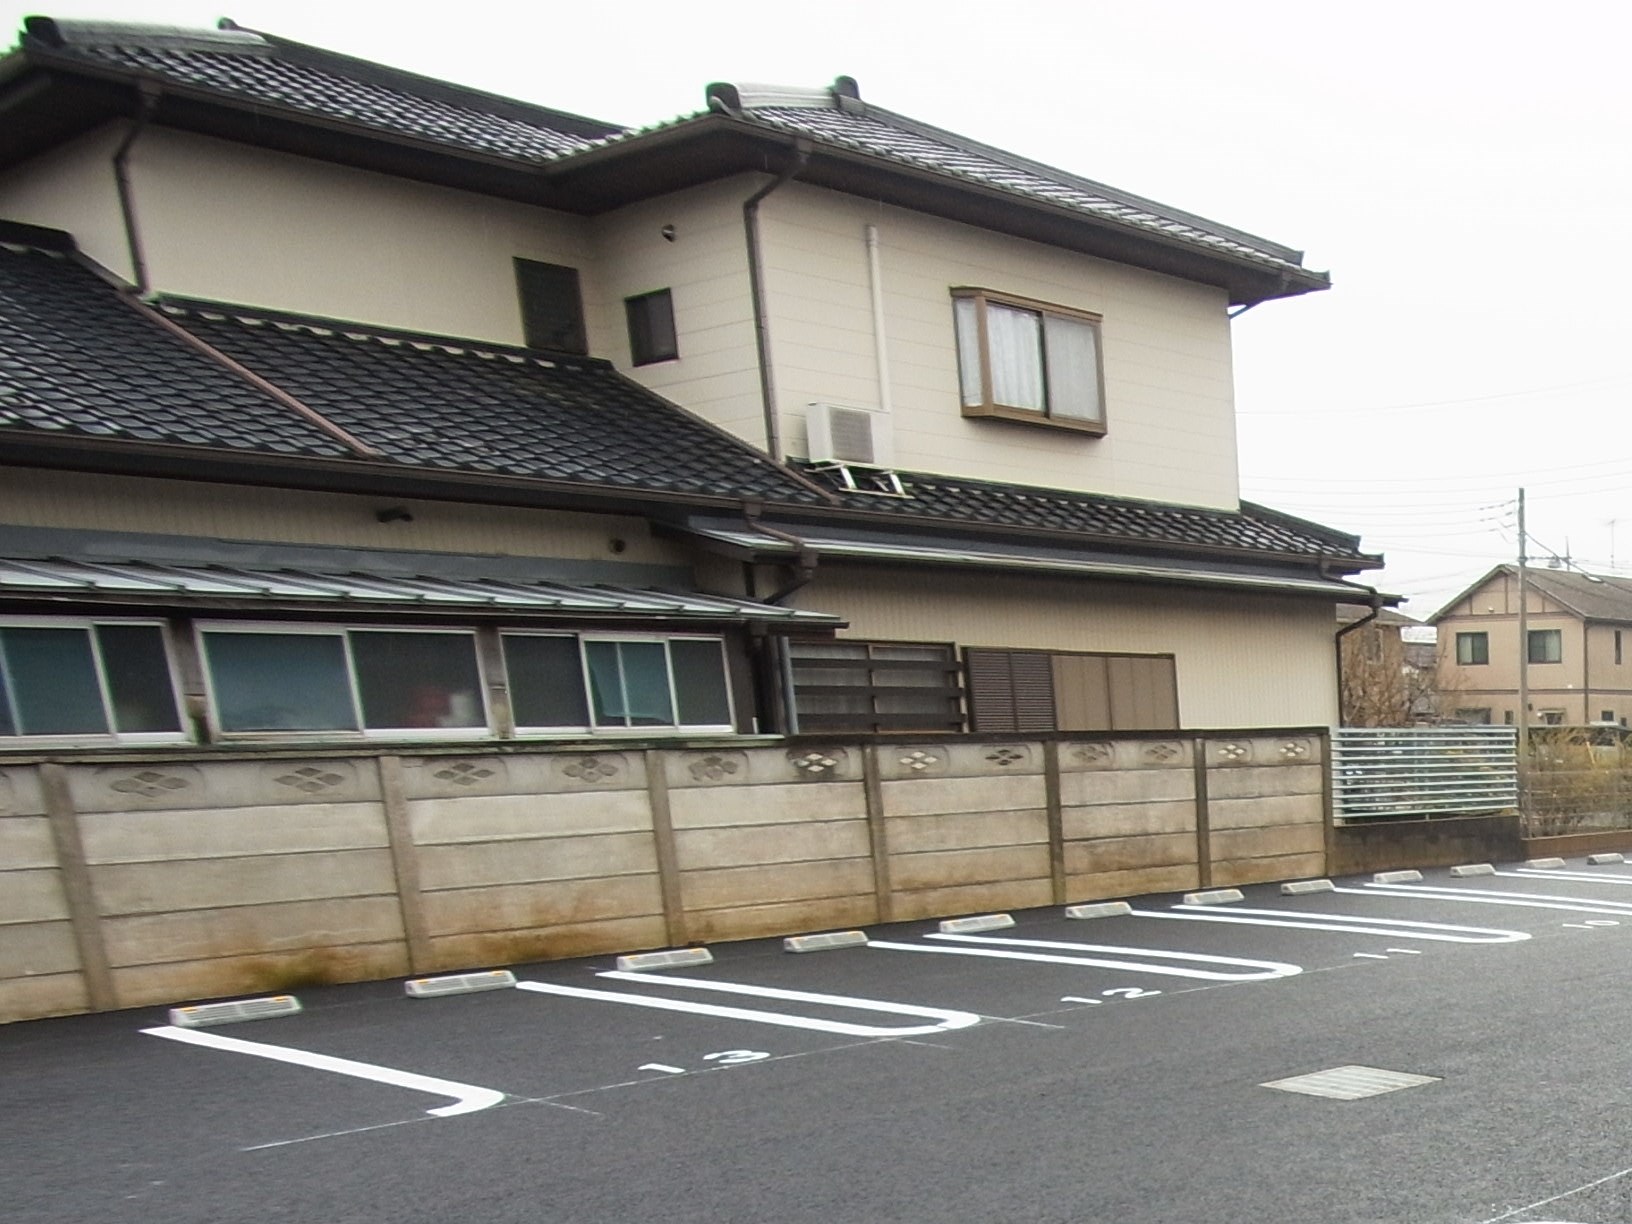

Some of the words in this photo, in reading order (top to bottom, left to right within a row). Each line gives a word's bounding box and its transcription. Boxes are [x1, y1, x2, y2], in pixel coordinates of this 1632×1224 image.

[1561, 918, 1621, 931] 10
[1352, 947, 1422, 960] 11
[1060, 987, 1163, 1005] 12
[637, 1049, 771, 1074] 13
